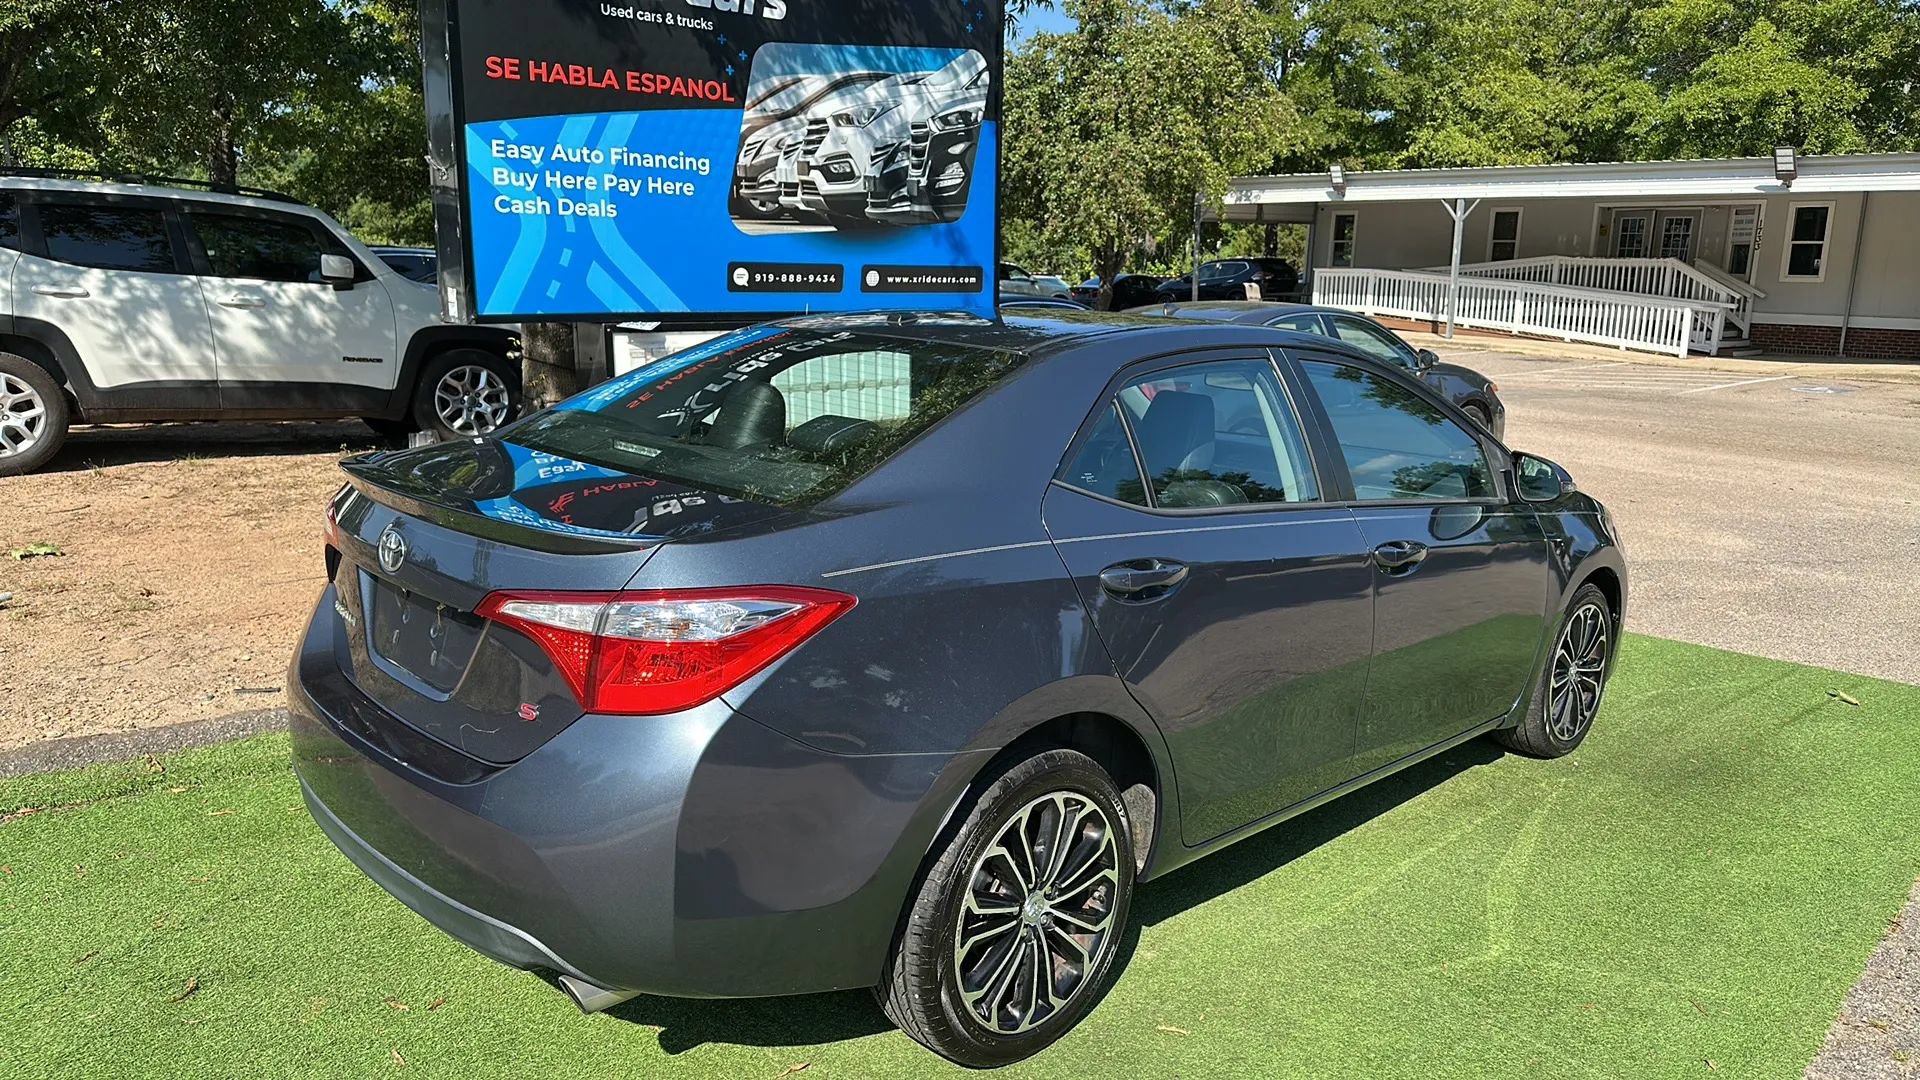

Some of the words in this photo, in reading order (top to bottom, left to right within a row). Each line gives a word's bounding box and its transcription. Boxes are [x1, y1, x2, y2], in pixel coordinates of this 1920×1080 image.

[600, 3, 633, 19] Used
[636, 9, 662, 23] cars
[665, 14, 675, 25] &
[676, 15, 714, 31] trucks
[485, 56, 521, 80] SE
[528, 60, 620, 90] HABLA
[626, 70, 735, 103] ESPANOL
[491, 139, 545, 164] Easy
[551, 143, 604, 164] Auto
[610, 147, 710, 176] Financing
[493, 167, 538, 192] Buy
[545, 170, 598, 191] Here
[603, 174, 642, 197] Pay
[648, 176, 695, 196] Here
[494, 194, 551, 215] Cash
[558, 198, 618, 218] Deals
[755, 273, 836, 284] 919-888-9434
[887, 275, 977, 285] www.xridecars.com
[518, 703, 540, 720] S
